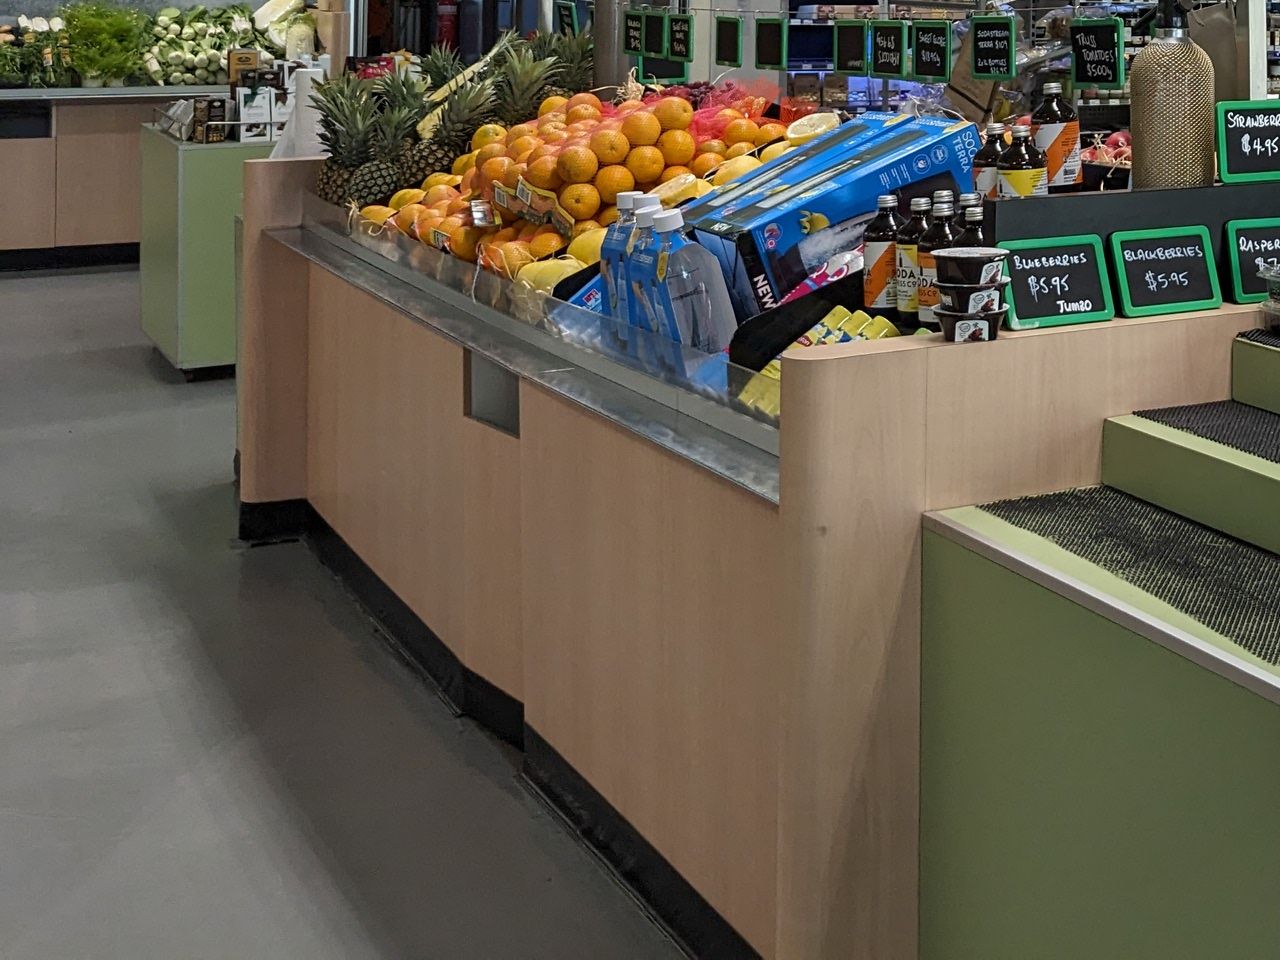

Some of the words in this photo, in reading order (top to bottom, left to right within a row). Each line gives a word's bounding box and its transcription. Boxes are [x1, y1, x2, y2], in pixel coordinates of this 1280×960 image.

[1075, 32, 1096, 48] TRUSS
[1082, 48, 1114, 62] TOMATOES
[952, 136, 970, 174] TERRA
[1241, 133, 1280, 156] $4.95
[1014, 252, 1088, 270] BLUEBERRIES
[1124, 244, 1203, 262] BLACKBERRIES
[754, 274, 777, 310] NEW
[1028, 274, 1070, 302] $5.95
[1144, 270, 1188, 292] $5.95
